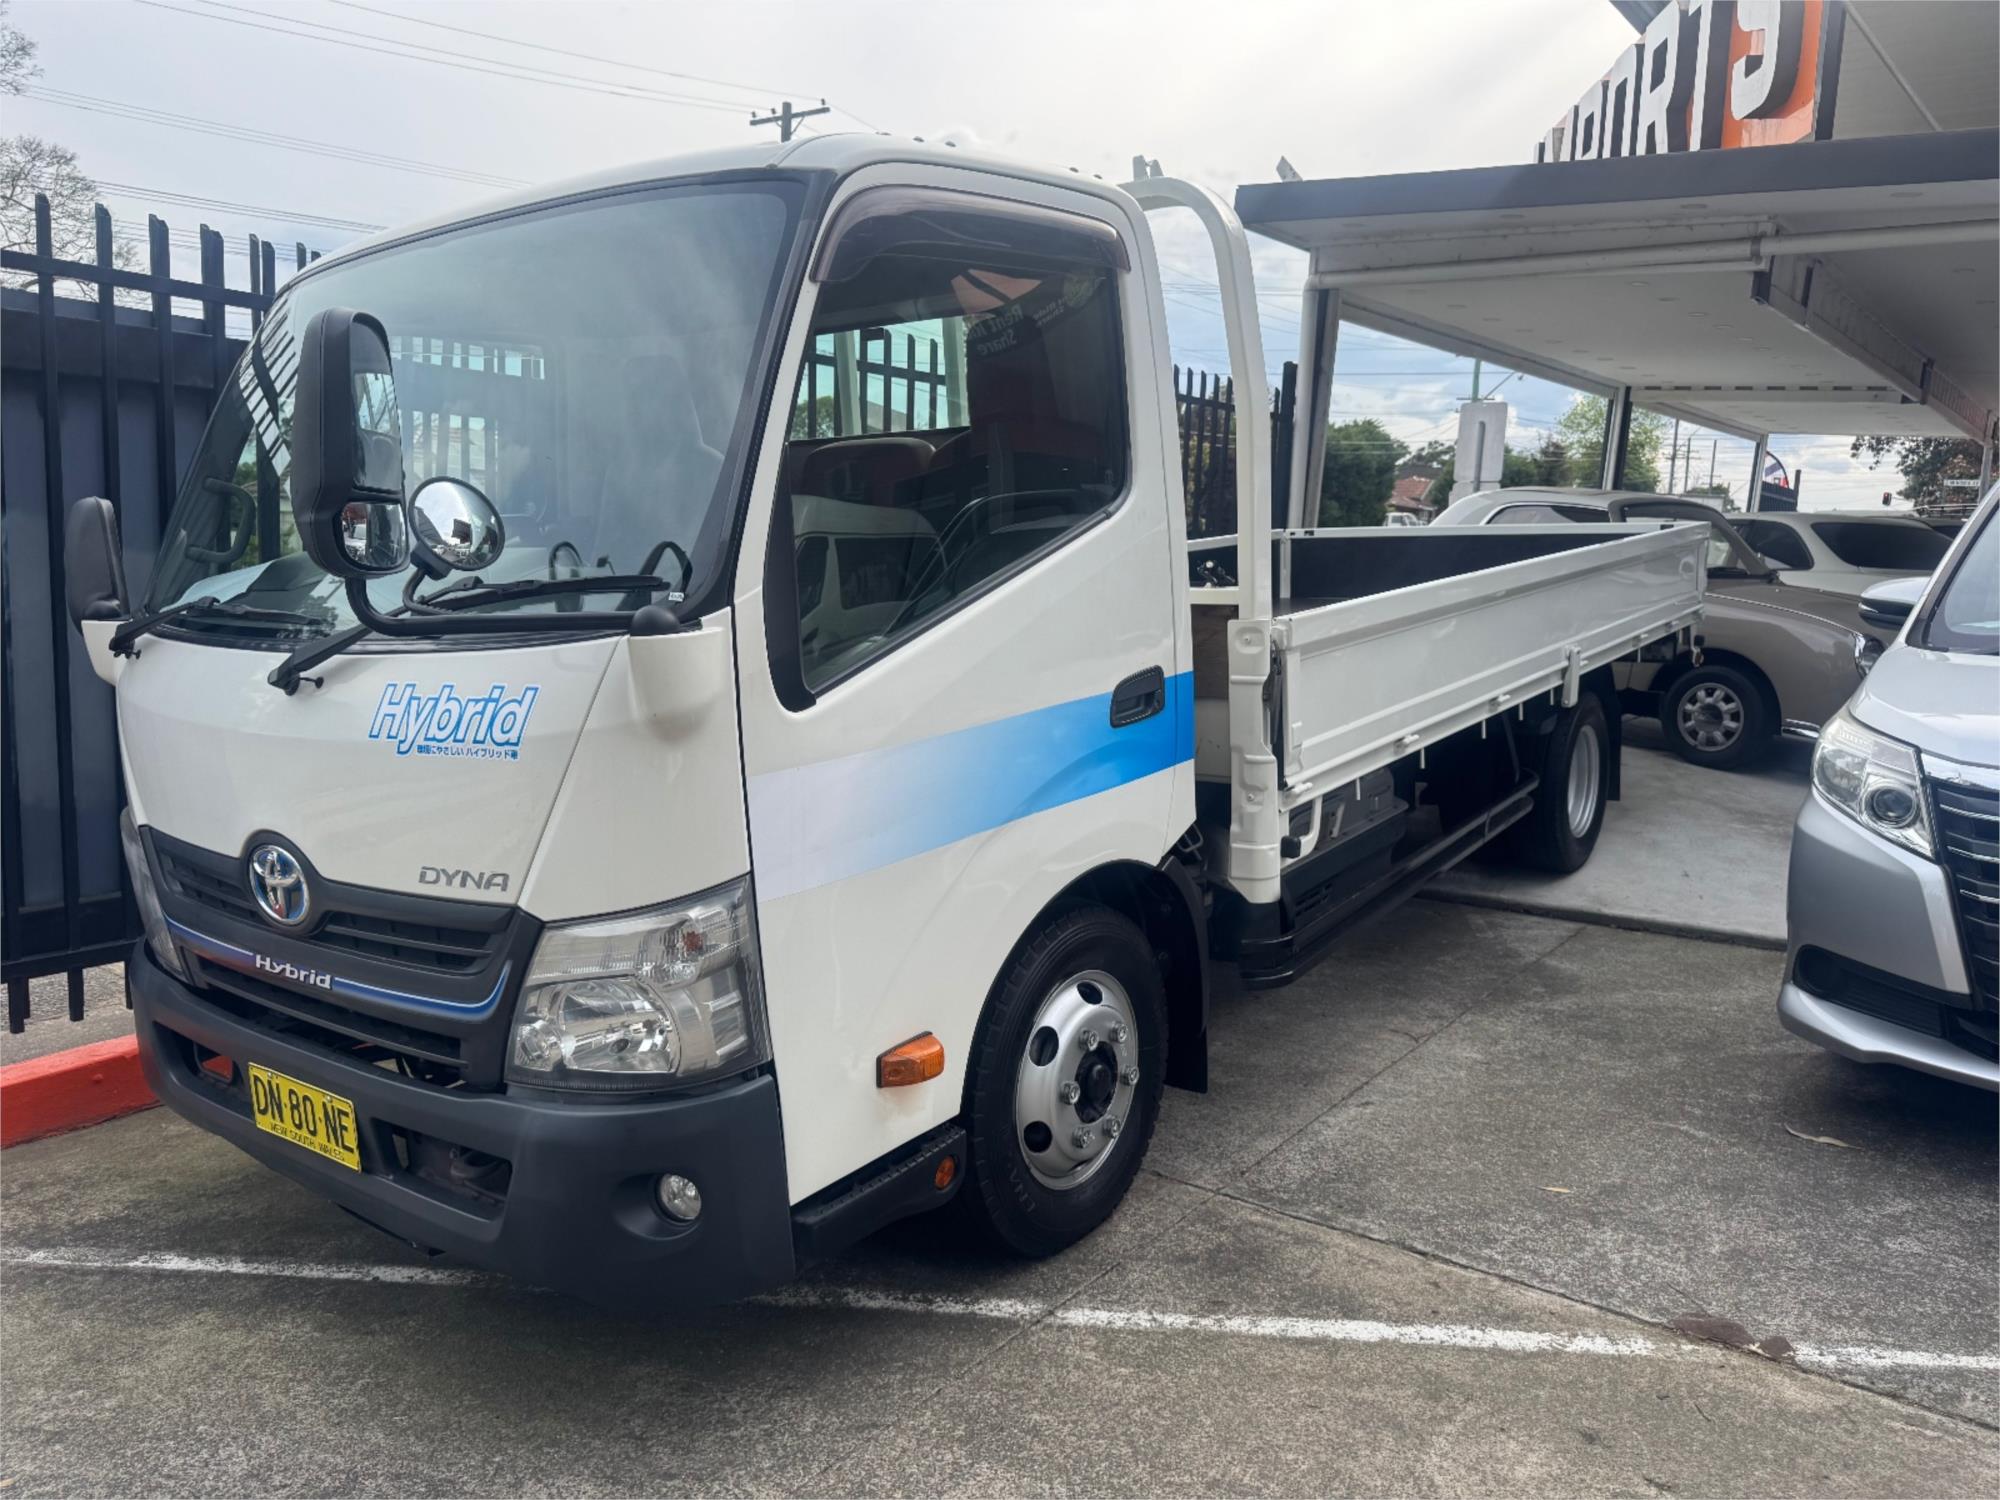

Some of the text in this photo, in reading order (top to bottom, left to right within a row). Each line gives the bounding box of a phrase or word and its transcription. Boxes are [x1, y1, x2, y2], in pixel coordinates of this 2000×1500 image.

[1533, 0, 1781, 163] PORTS
[368, 683, 539, 754] Hybrid
[418, 866, 510, 892] DYNA
[255, 954, 331, 989] Hybrid
